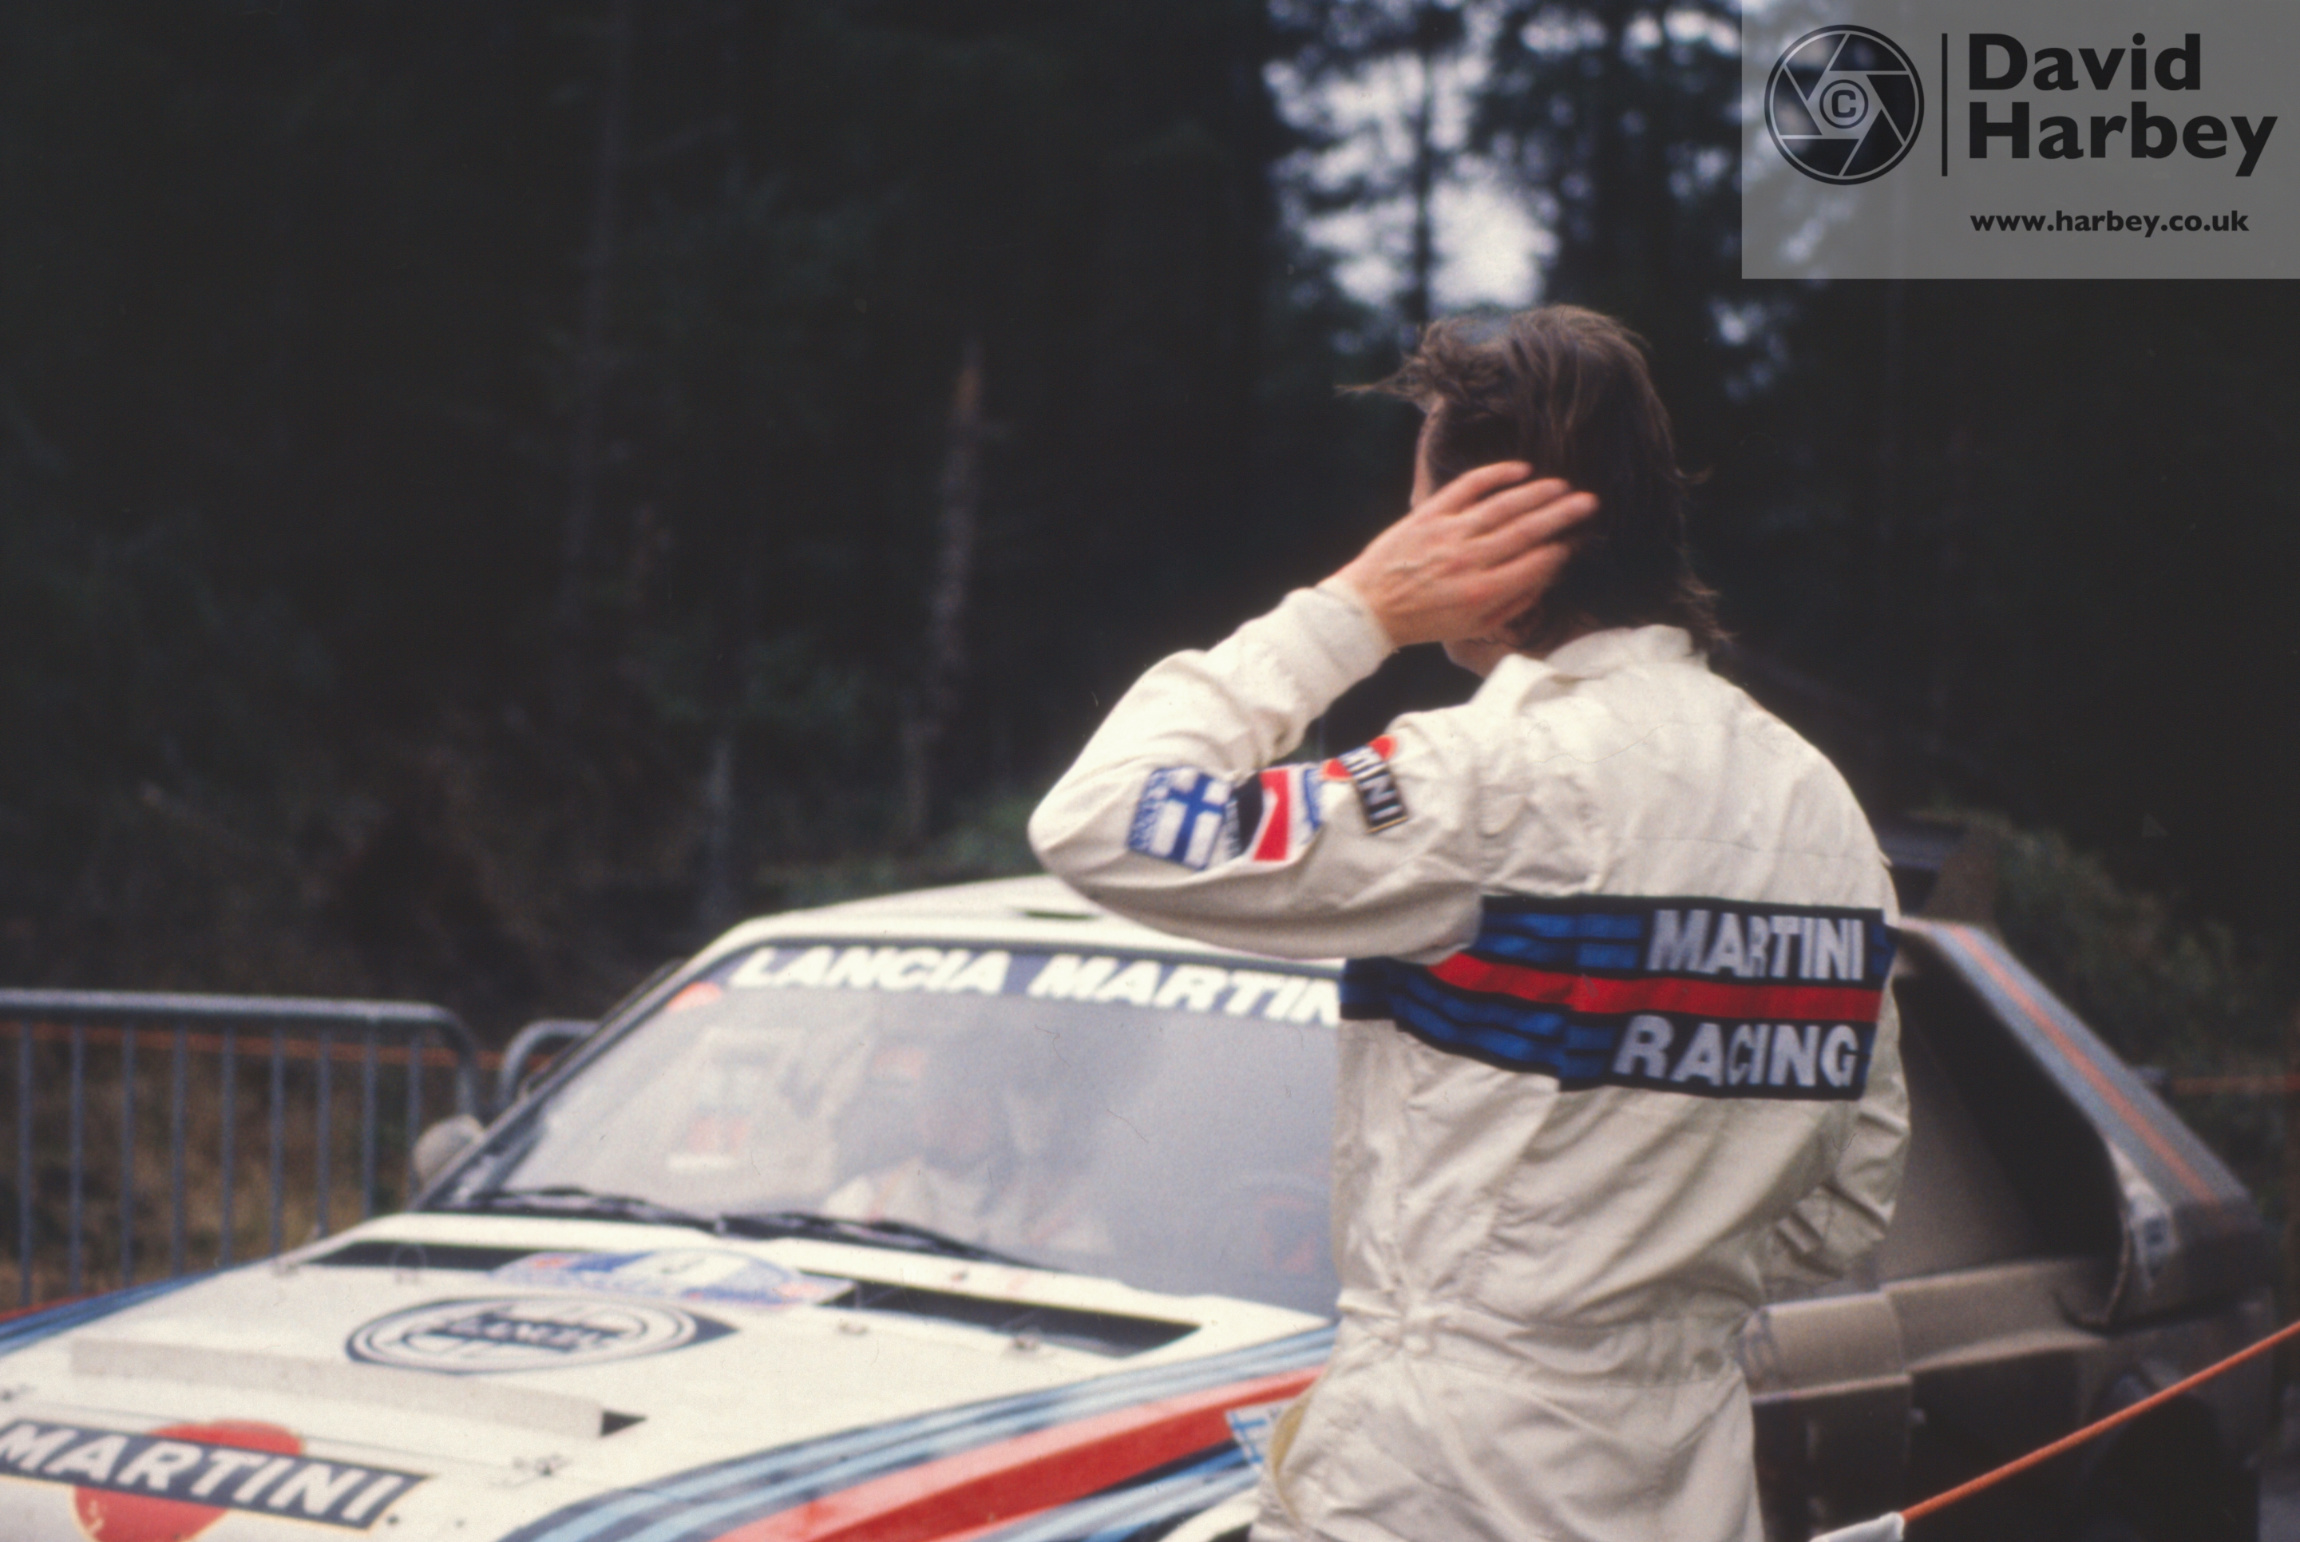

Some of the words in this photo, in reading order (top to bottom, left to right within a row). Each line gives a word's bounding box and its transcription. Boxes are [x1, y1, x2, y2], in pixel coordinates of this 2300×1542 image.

[1645, 908, 1864, 981] MARTINI
[729, 946, 1013, 997] LANCIA
[1027, 952, 1340, 1028] MARTIN
[1612, 1014, 1860, 1088] RACING
[0, 1423, 403, 1521] MARTINI
